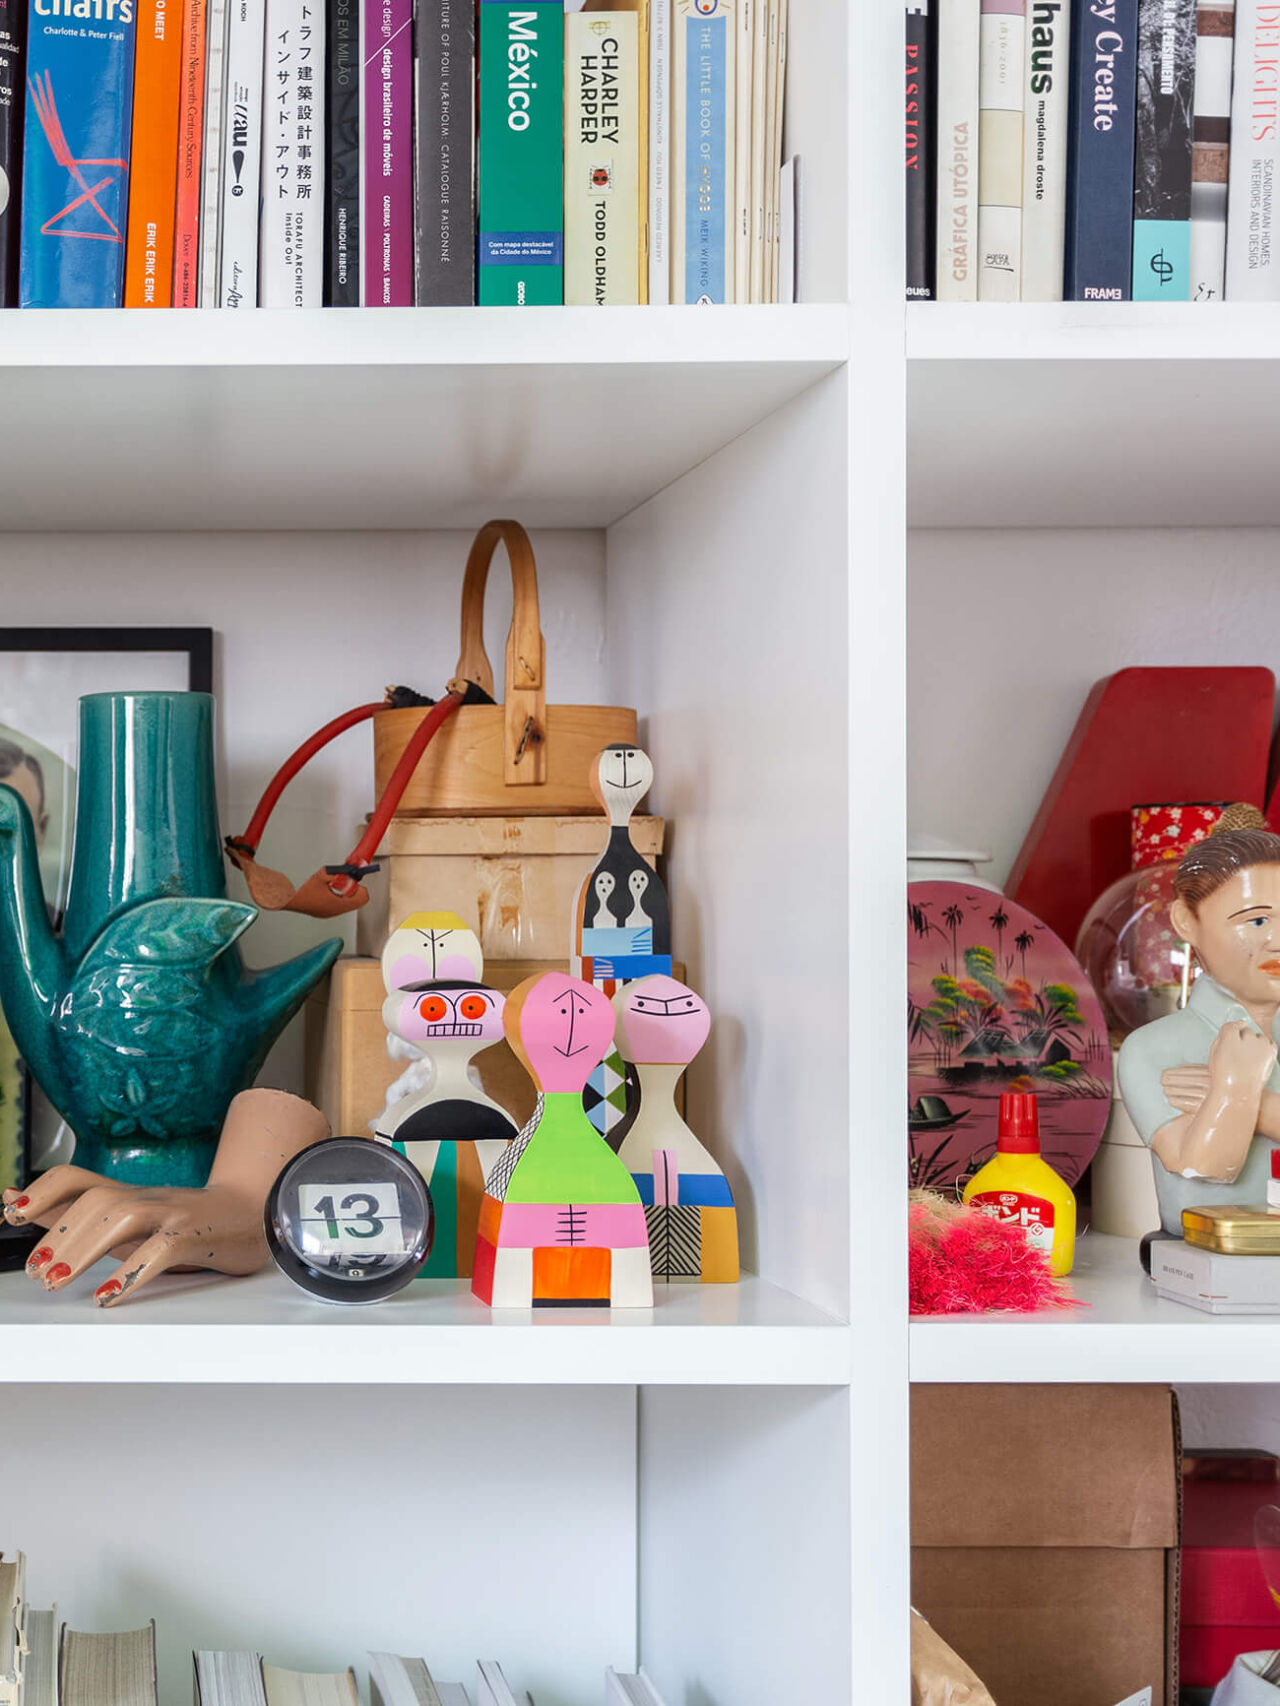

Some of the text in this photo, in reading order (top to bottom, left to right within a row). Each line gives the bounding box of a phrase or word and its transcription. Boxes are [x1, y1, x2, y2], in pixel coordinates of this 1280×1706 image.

[43, 26, 124, 41] Charlotte & Peter Fiell
[154, 11, 165, 41] MEET
[189, 34, 200, 55] from
[337, 19, 351, 86] EM MILÃO
[381, 8, 393, 38] design
[440, 33, 450, 47] OF
[1030, 3, 1061, 94] haus
[440, 52, 450, 77] POUL
[508, 11, 538, 131] México
[601, 38, 619, 144] CHARLEY
[1093, 31, 1123, 131] Create
[1160, 28, 1176, 94] PENSAMENTO
[276, 30, 291, 199] インサイド・アウト
[296, 6, 314, 199] トラフ建築設計事務所
[381, 49, 394, 177] design brasileiro de móveis
[581, 55, 598, 144] HARPER
[905, 45, 919, 170] PASSION
[184, 143, 195, 178] Sources
[440, 145, 450, 204] CATALOGUE
[698, 27, 711, 287] THE LITTLE BOOK OF HYGGE MEIK WIKING
[1034, 100, 1047, 200] magdalena droste
[594, 201, 606, 242] TODD
[949, 122, 969, 281] GRÁFICA UTÓPICA
[1248, 159, 1261, 269] INTERIORS AND DESIGN
[1261, 159, 1274, 229] SCANDINAVIAN
[144, 223, 157, 303] ERIK ERIK ERIK
[284, 213, 293, 265] Inside Out
[295, 212, 303, 250] TORAFU
[338, 208, 347, 284] HENRIQUE RIBEIRO
[382, 195, 391, 304] CADEIRAS POLTRONAS BANCOS
[440, 209, 451, 263] RAISONNÉ
[522, 240, 553, 248] destacável
[314, 1193, 384, 1239] 13
